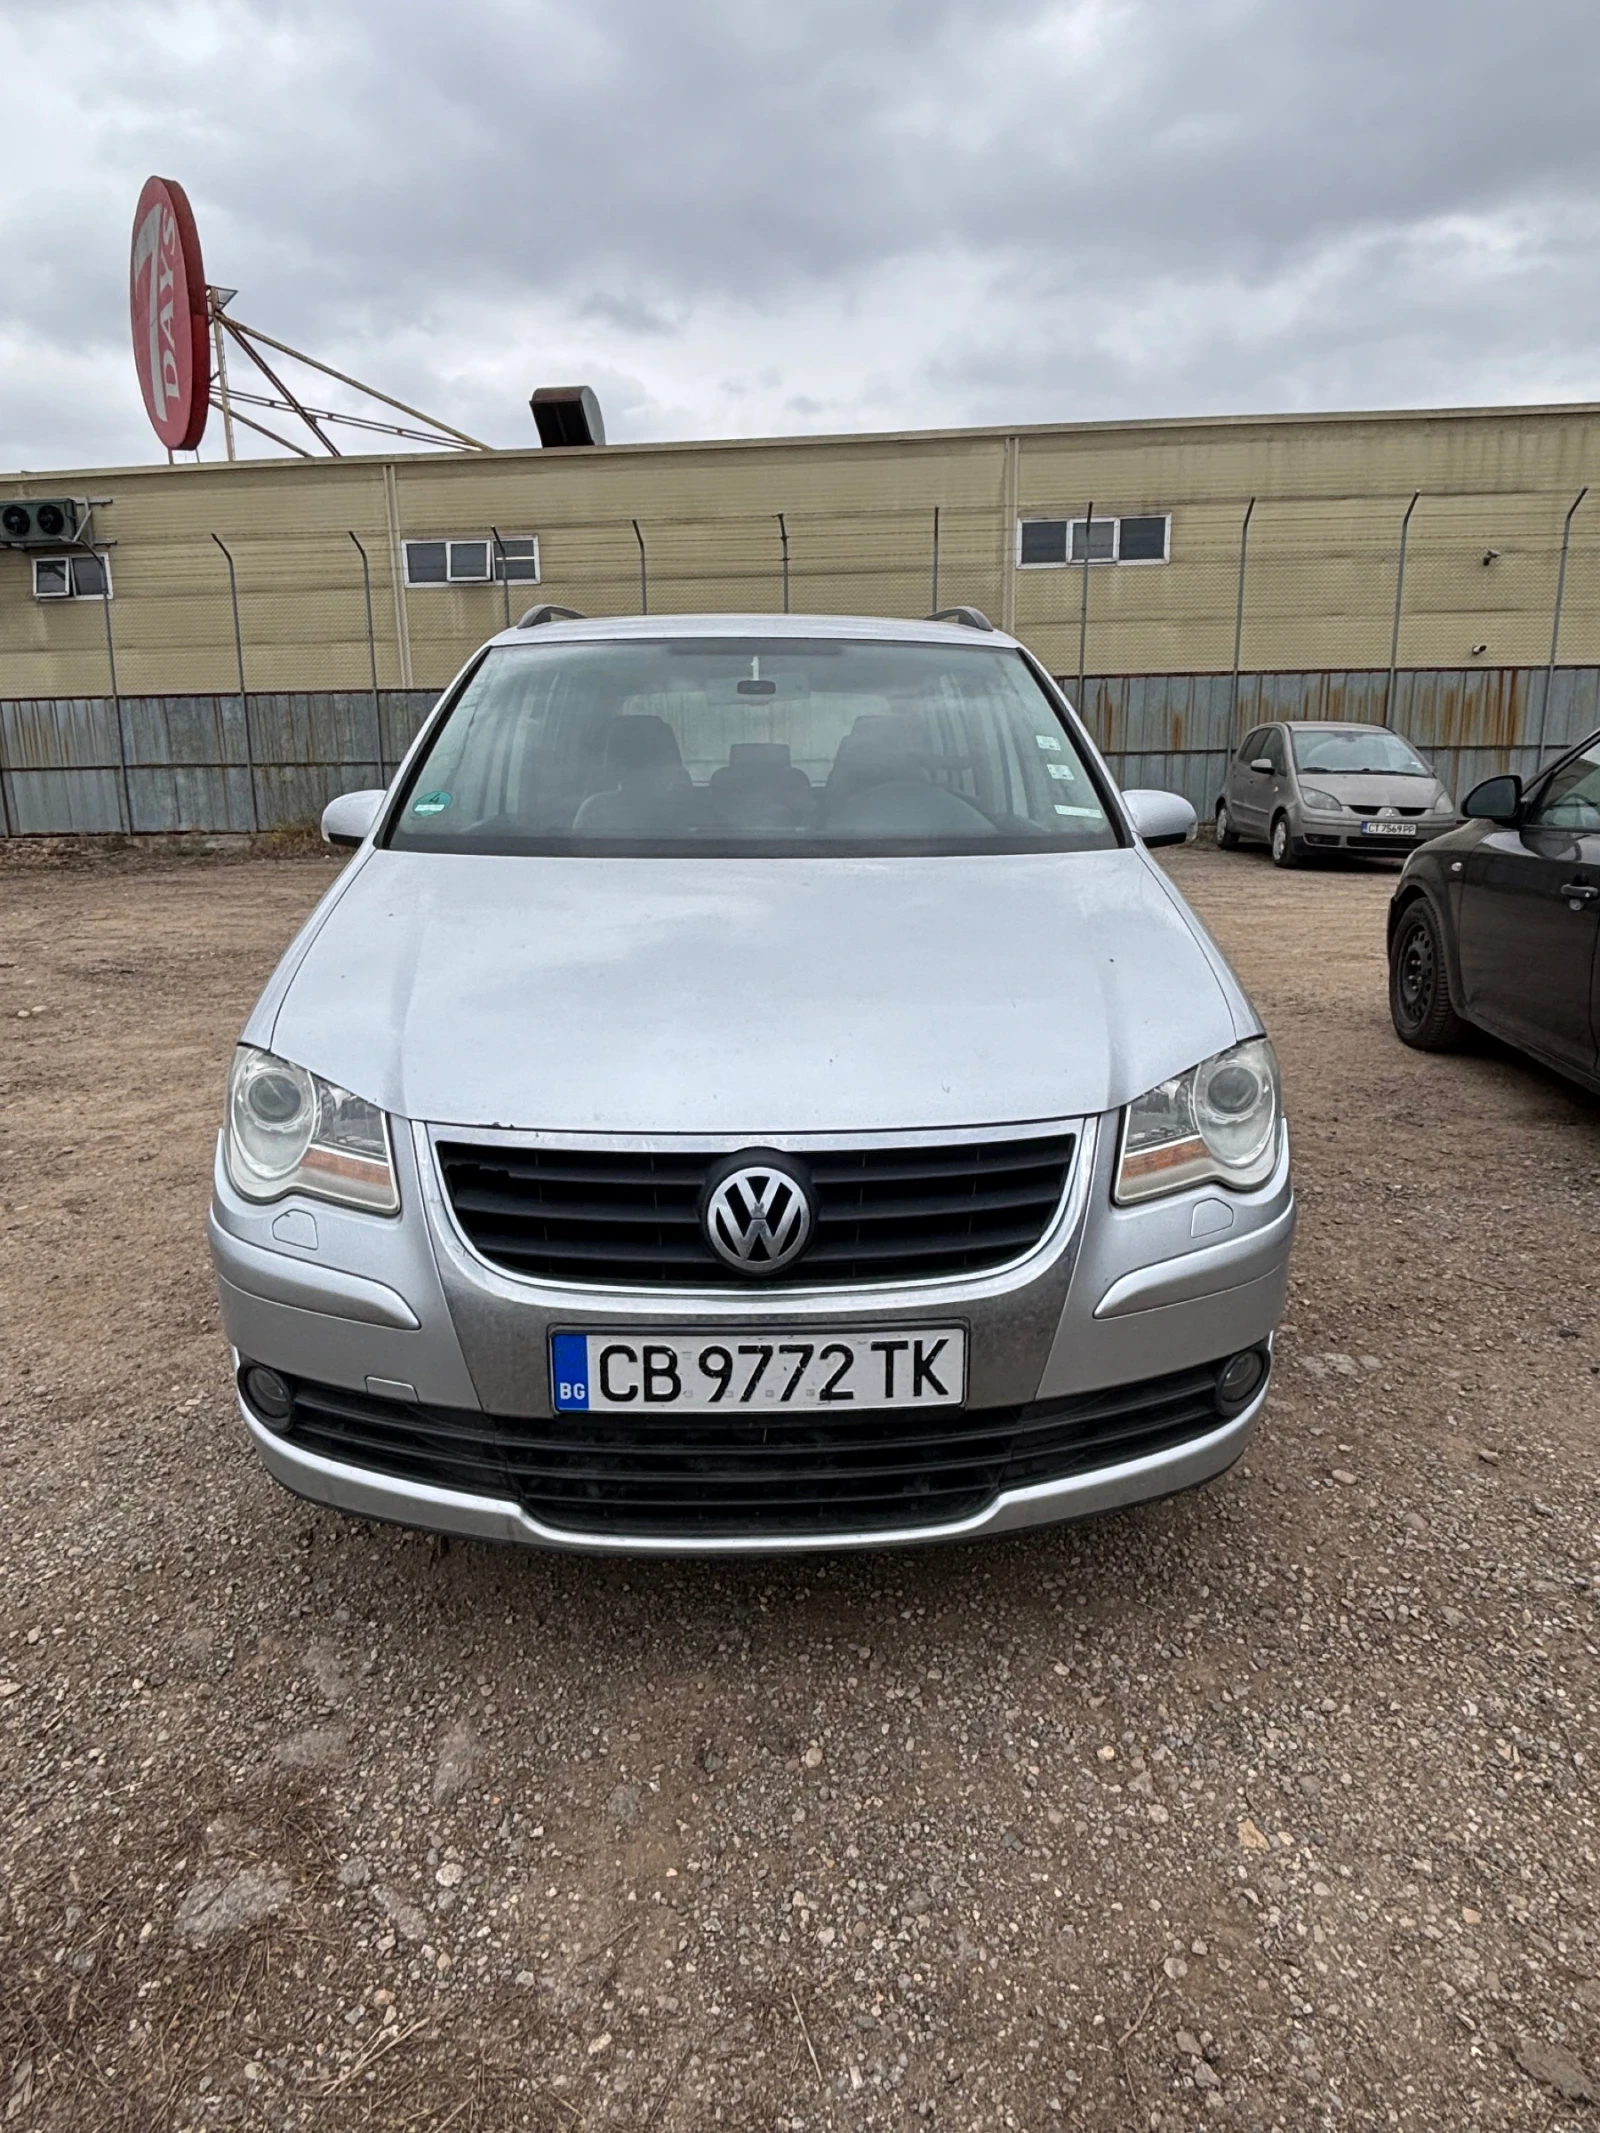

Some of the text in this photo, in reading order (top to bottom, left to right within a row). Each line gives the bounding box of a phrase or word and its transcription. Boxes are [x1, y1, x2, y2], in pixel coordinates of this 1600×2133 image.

[134, 203, 168, 422] 7
[159, 208, 181, 400] DAYS
[1368, 824, 1415, 834] CT 7569 PP
[708, 1167, 810, 1270] VW
[559, 1382, 586, 1400] BG
[598, 1338, 951, 1404] CB 9772 TK
